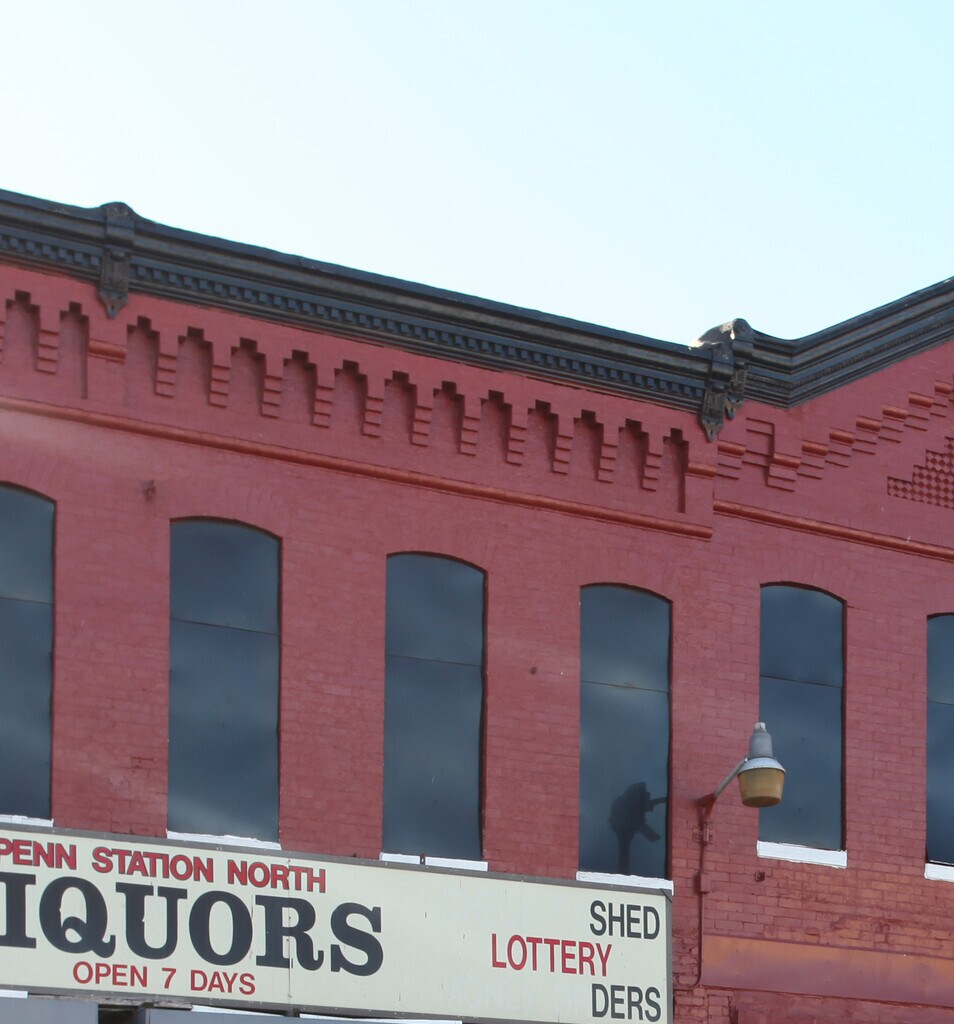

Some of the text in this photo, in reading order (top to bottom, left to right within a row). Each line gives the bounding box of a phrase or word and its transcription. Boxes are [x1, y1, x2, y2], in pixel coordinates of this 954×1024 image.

[0, 838, 326, 893] PENN STATION NORTH
[589, 900, 660, 940] SHED
[492, 933, 612, 977] LOTTERY
[73, 961, 256, 995] OPEN 7 DAYS
[591, 983, 662, 1022] DERS
